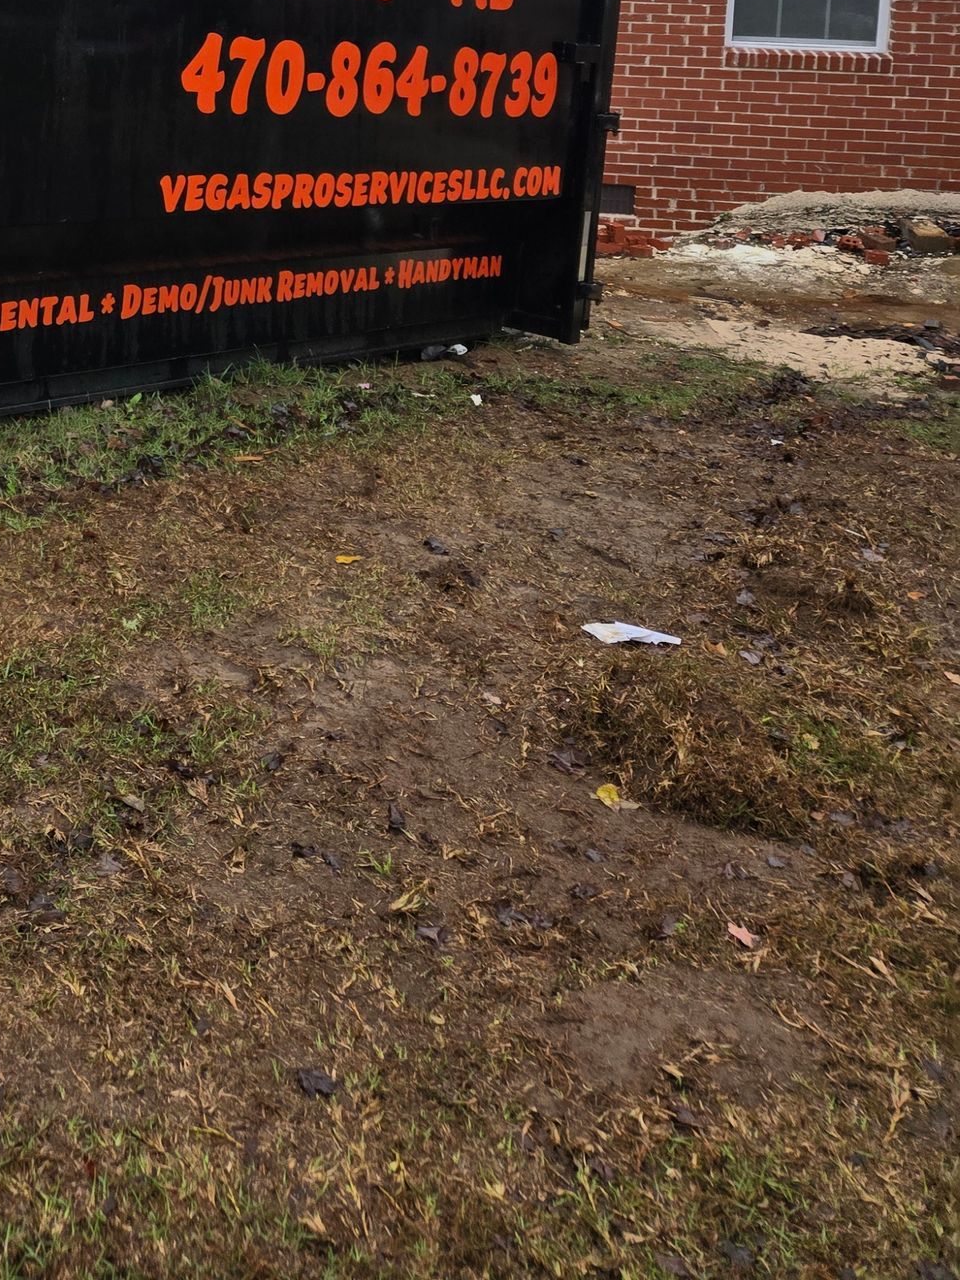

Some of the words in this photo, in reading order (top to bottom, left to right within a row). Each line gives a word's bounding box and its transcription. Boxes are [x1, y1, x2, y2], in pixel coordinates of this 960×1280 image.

[180, 32, 558, 119] 470-864-8739
[159, 165, 561, 213] VEGASPROSERVICESLLC.COM
[120, 274, 273, 320] DEMO/JUNK
[276, 266, 380, 303] REMOVAL
[397, 255, 502, 289] HANDYMAN
